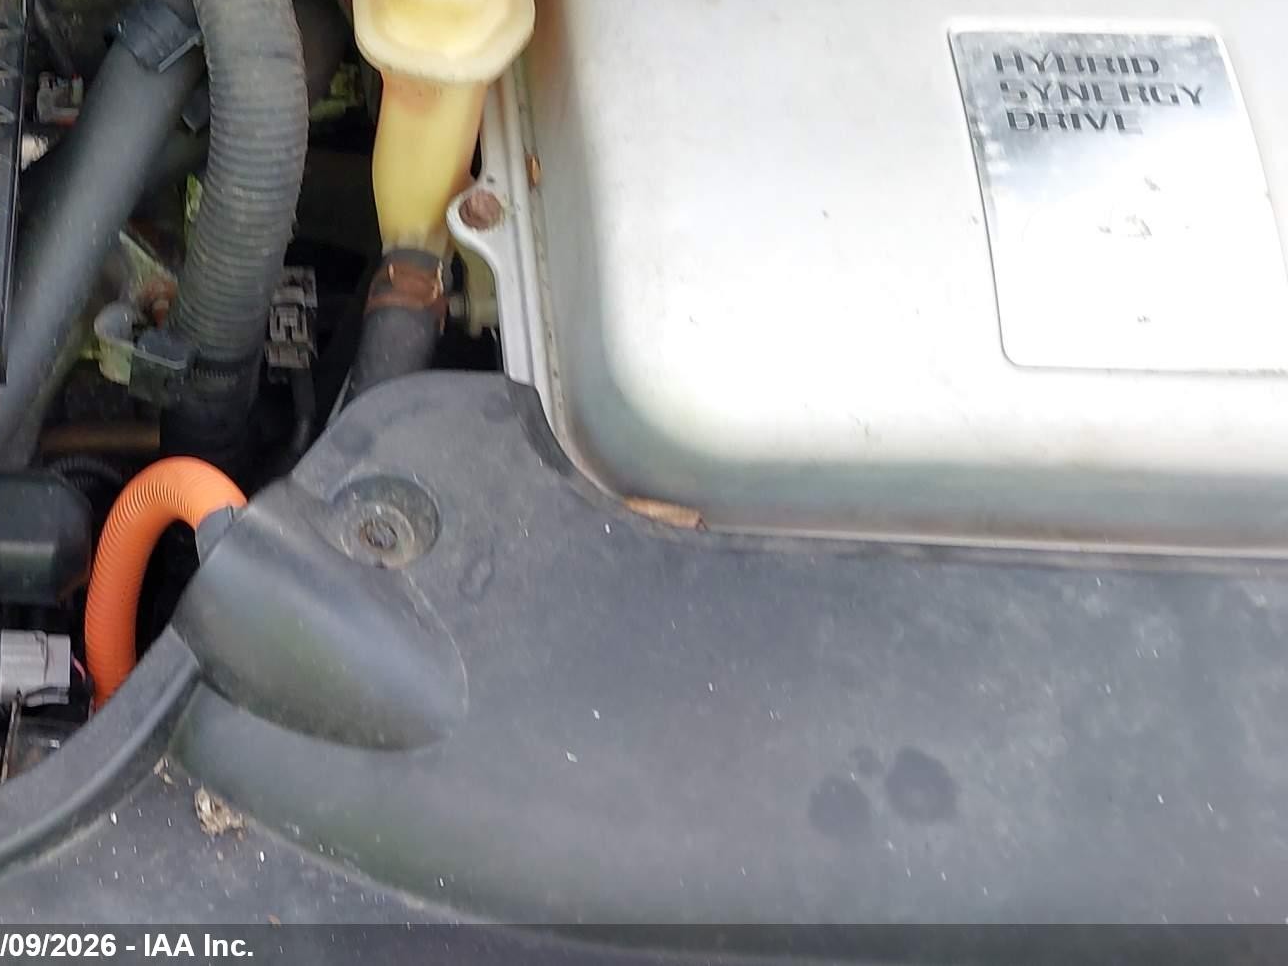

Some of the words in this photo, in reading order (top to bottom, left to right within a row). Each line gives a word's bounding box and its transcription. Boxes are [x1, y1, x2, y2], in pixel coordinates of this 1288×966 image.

[993, 50, 1160, 75] HYBRID
[999, 81, 1203, 106] SYNERGY
[1006, 110, 1144, 134] DRIVE
